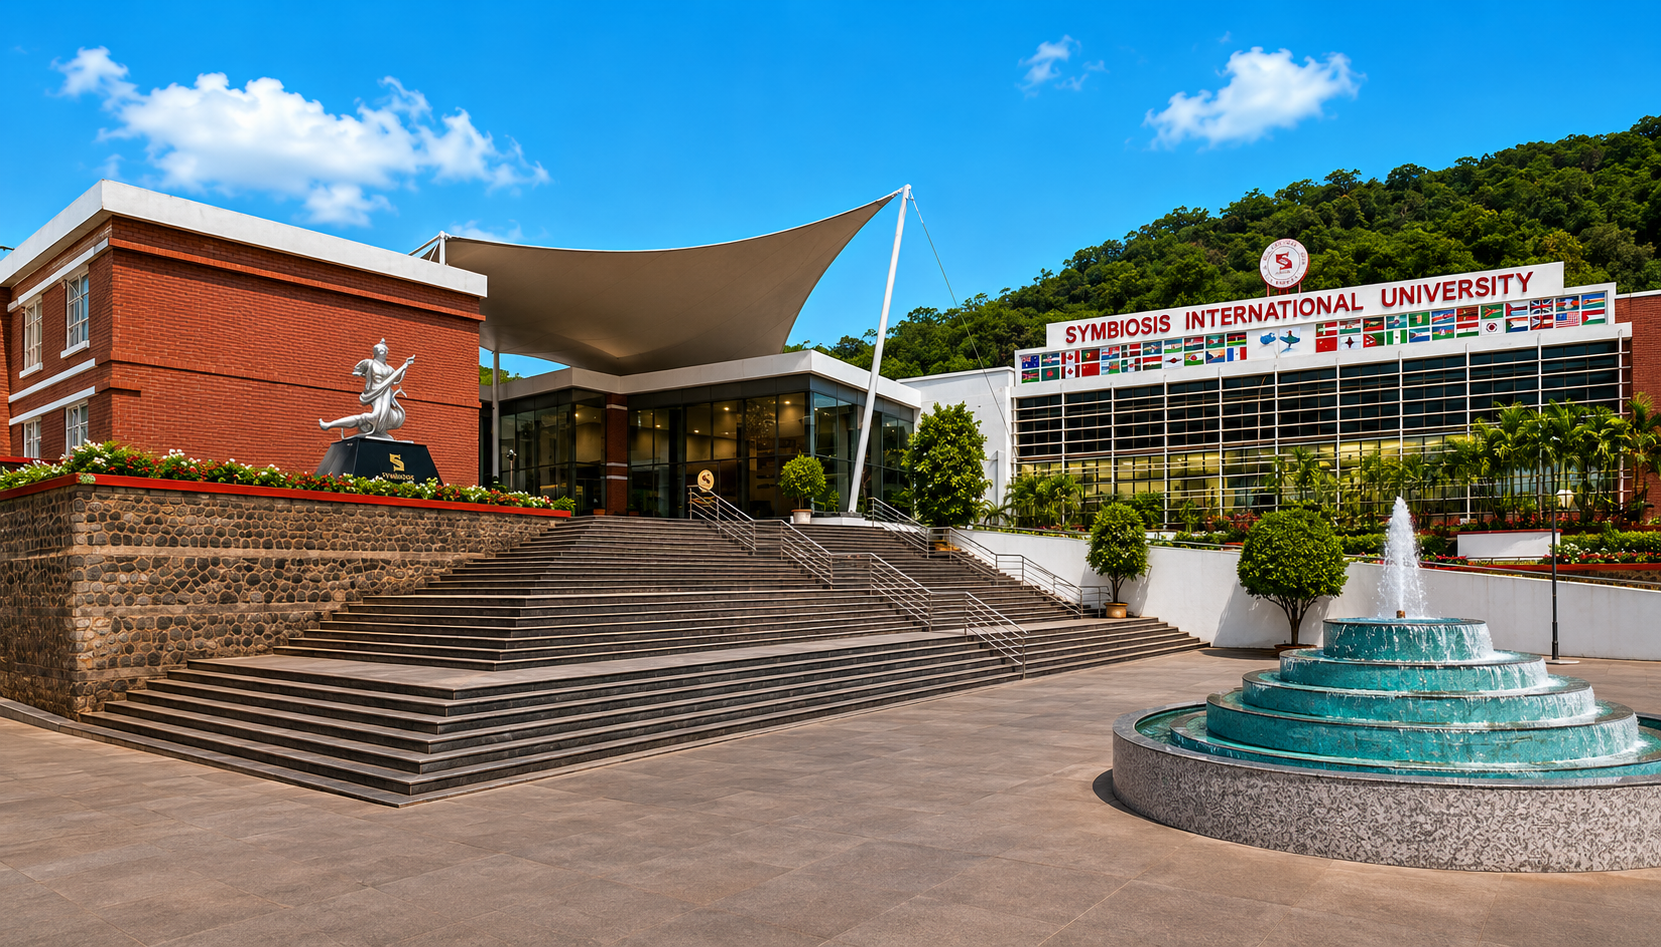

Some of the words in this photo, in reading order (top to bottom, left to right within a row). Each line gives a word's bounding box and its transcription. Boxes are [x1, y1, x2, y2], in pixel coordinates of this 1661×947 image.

[1065, 314, 1171, 344] SYMBIOSIS
[1185, 292, 1364, 330] INTERNATIONAL
[1381, 271, 1534, 307] UNIVERSITY
